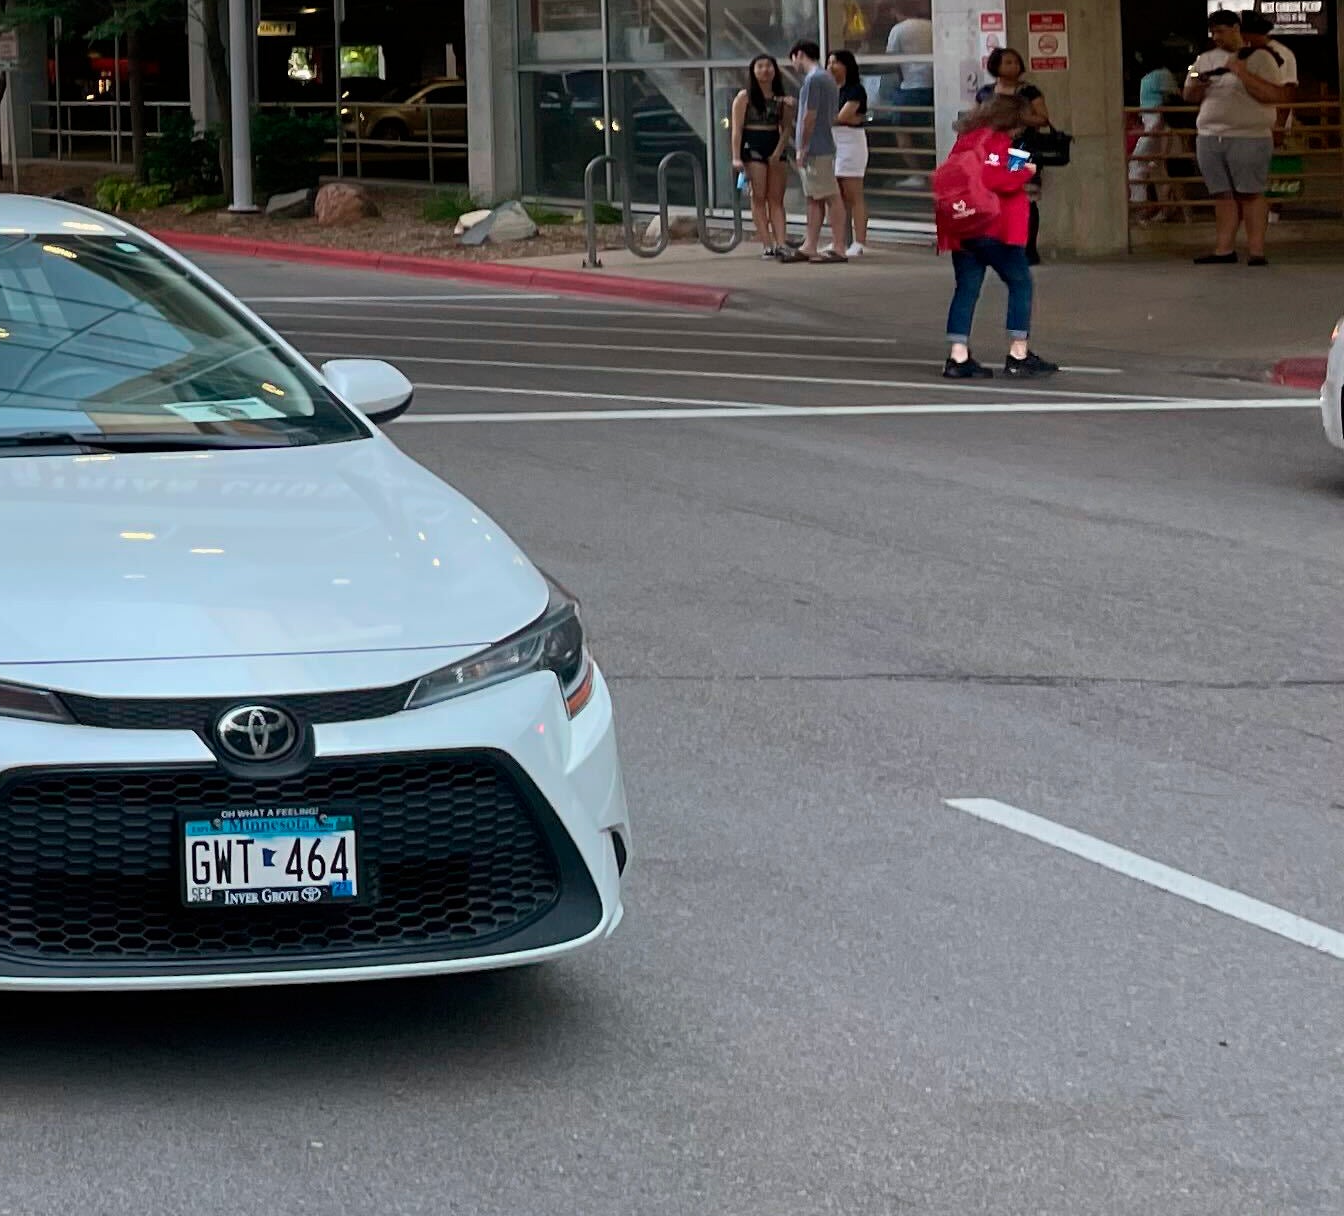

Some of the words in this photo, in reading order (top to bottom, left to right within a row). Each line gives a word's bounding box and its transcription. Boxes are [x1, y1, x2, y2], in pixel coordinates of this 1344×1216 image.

[221, 810, 236, 819] OH
[237, 809, 265, 818] WHAT
[266, 808, 275, 817] A
[276, 807, 319, 817] FEELING!
[191, 838, 255, 885] GWT
[285, 837, 349, 883] 464
[192, 887, 212, 902] SEP
